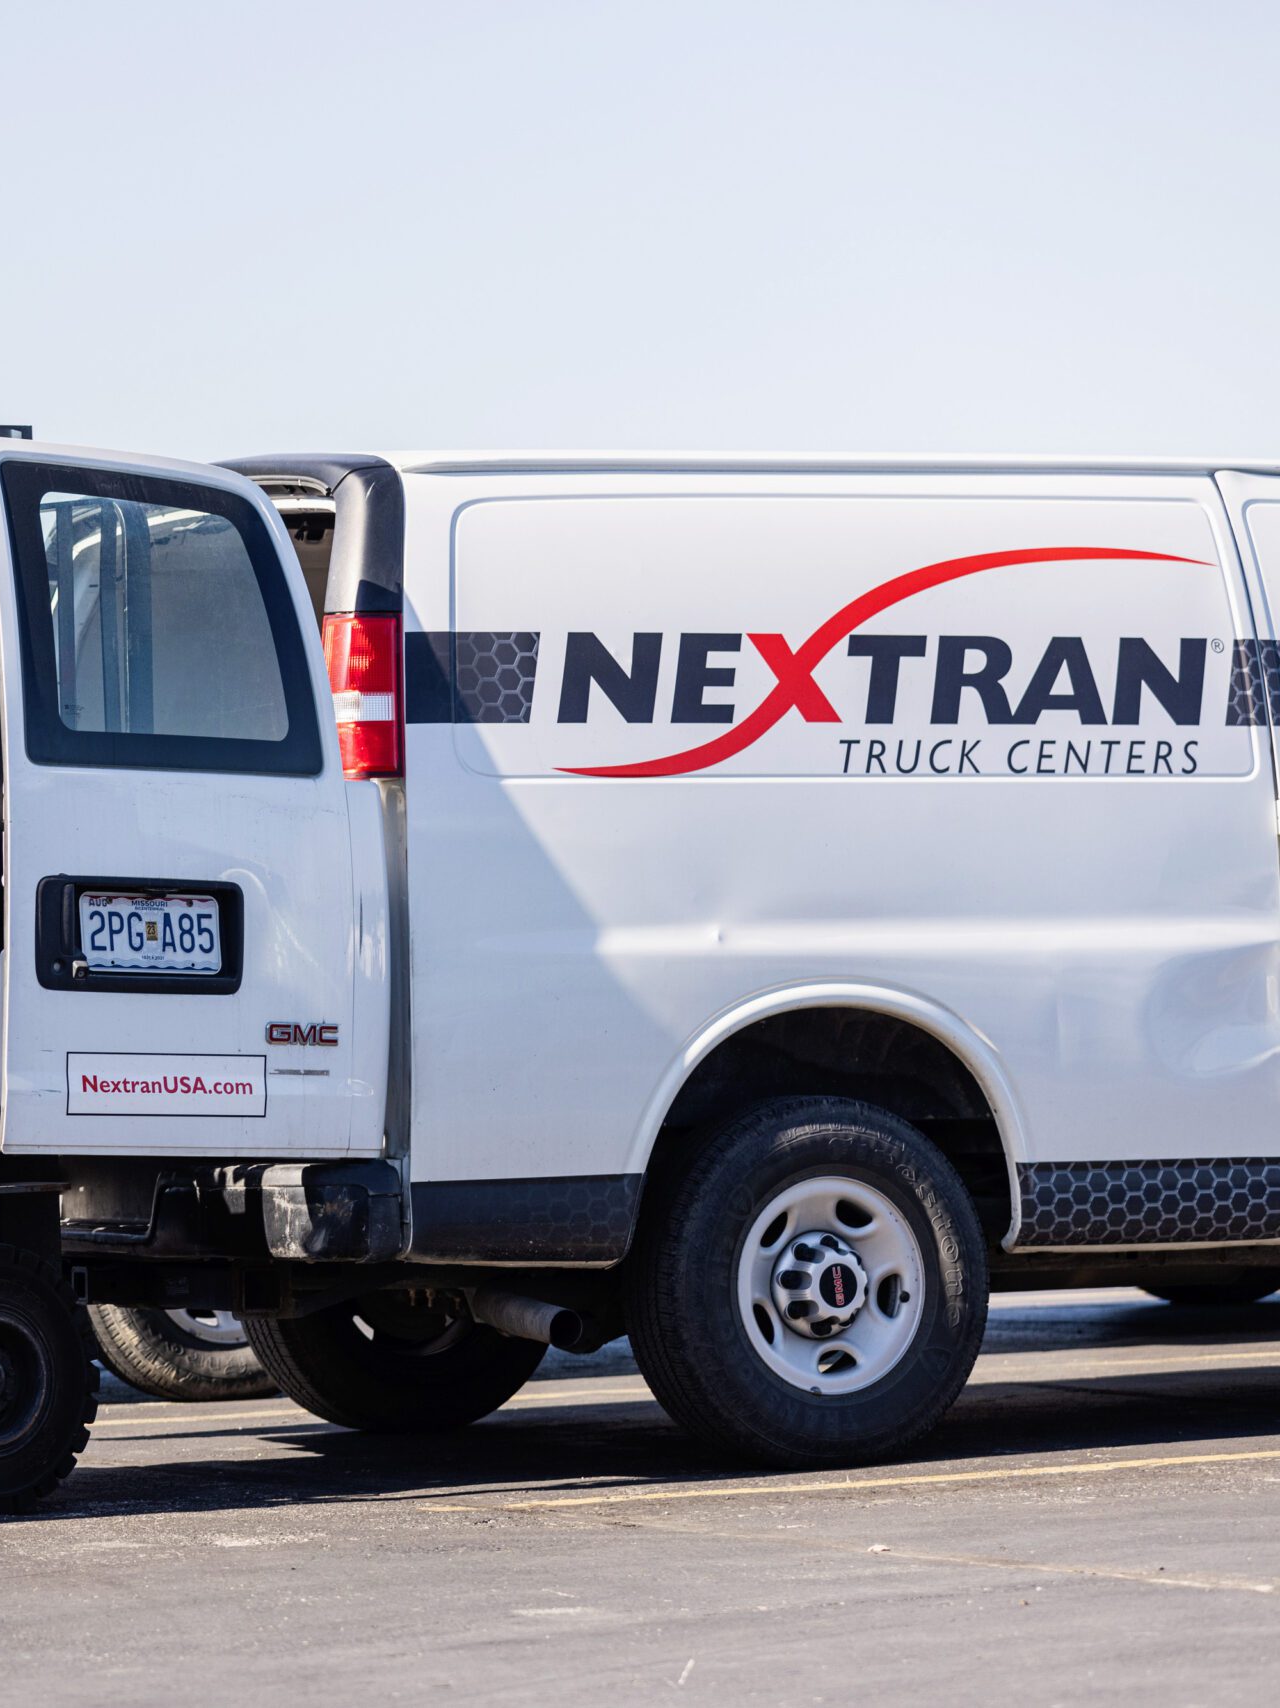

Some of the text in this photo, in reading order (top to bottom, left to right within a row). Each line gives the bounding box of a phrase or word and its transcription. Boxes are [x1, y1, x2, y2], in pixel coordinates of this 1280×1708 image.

[556, 631, 1208, 726] NEXTRAN
[839, 739, 1199, 775] TRUCK CENTERS
[131, 900, 169, 908] MISSOURI
[89, 910, 215, 954] 2PG A85
[266, 1022, 338, 1046] GMC
[81, 1075, 253, 1095] NextranUSA.com
[832, 1265, 845, 1306] GMC
